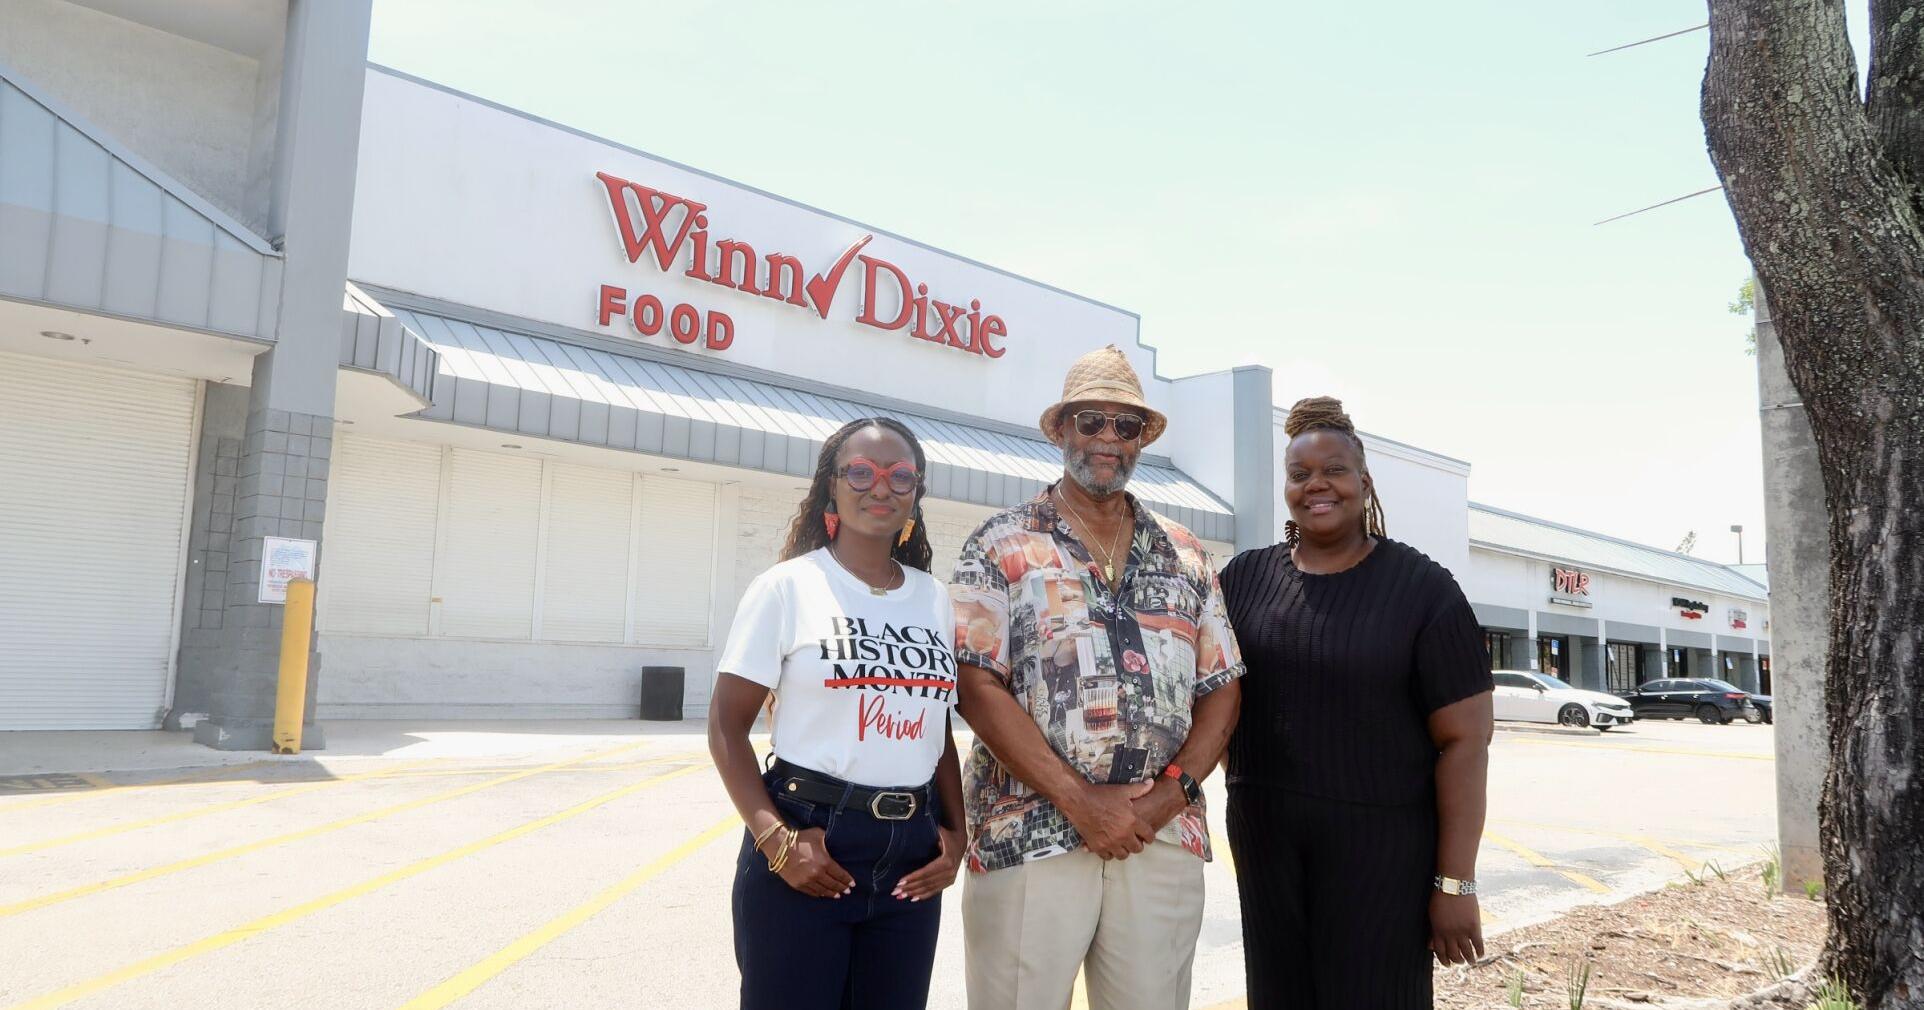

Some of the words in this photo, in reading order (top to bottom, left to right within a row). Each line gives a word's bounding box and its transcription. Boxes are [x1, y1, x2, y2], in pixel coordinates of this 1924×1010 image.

[596, 171, 808, 308] Winn
[855, 254, 1008, 359] Dixie
[598, 284, 735, 351] FOOD
[1553, 568, 1591, 596] DTLR
[832, 617, 948, 650] BLACK
[832, 663, 955, 703] MONTH
[858, 693, 926, 742] Period
